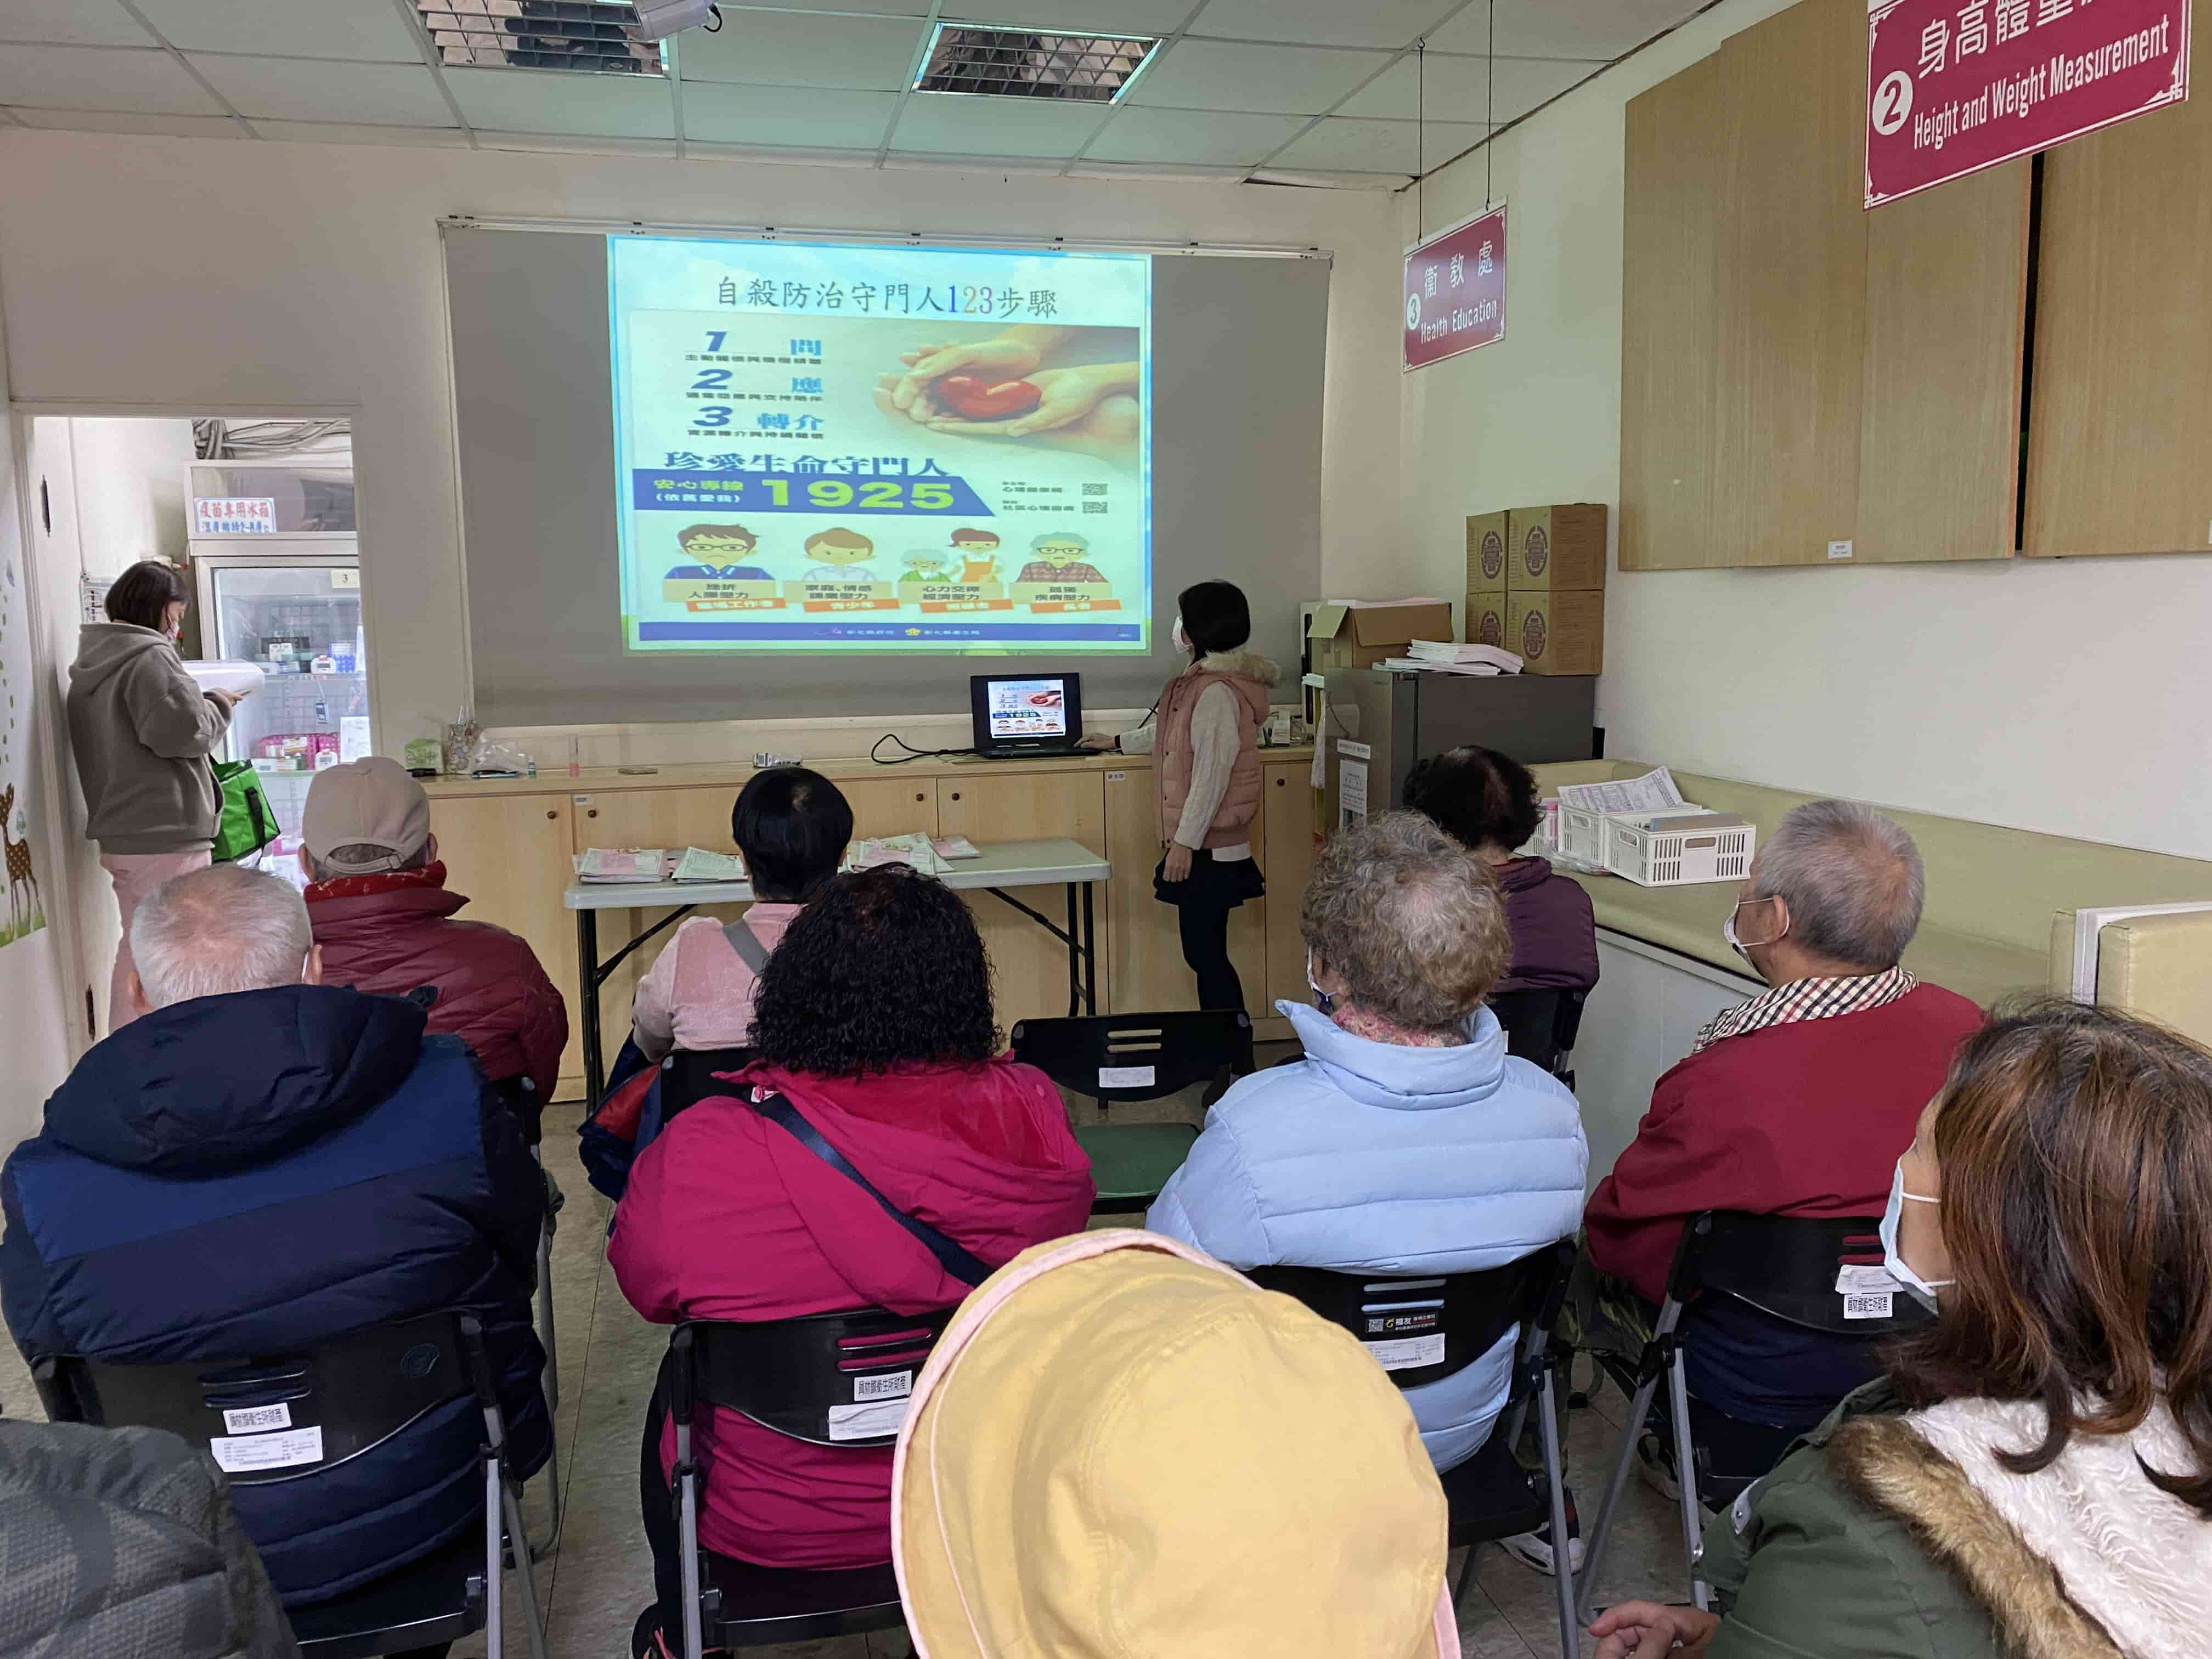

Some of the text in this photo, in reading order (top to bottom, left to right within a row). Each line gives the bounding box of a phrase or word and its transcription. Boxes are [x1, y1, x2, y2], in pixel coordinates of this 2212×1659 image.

[1914, 13, 2170, 150] Height and Weight Measurement
[1424, 240, 1493, 299] 衛教處
[717, 276, 1058, 319] 自殺防治守門人123步驟
[1421, 298, 1497, 344] Health Education
[706, 331, 728, 352] 1
[791, 338, 822, 356] 問
[691, 369, 733, 390] 2
[693, 405, 733, 427] 3
[758, 413, 825, 431] 轉介
[663, 452, 950, 476] 珍愛生命守門人
[653, 479, 744, 491] 安心專線
[761, 478, 955, 510] 1925
